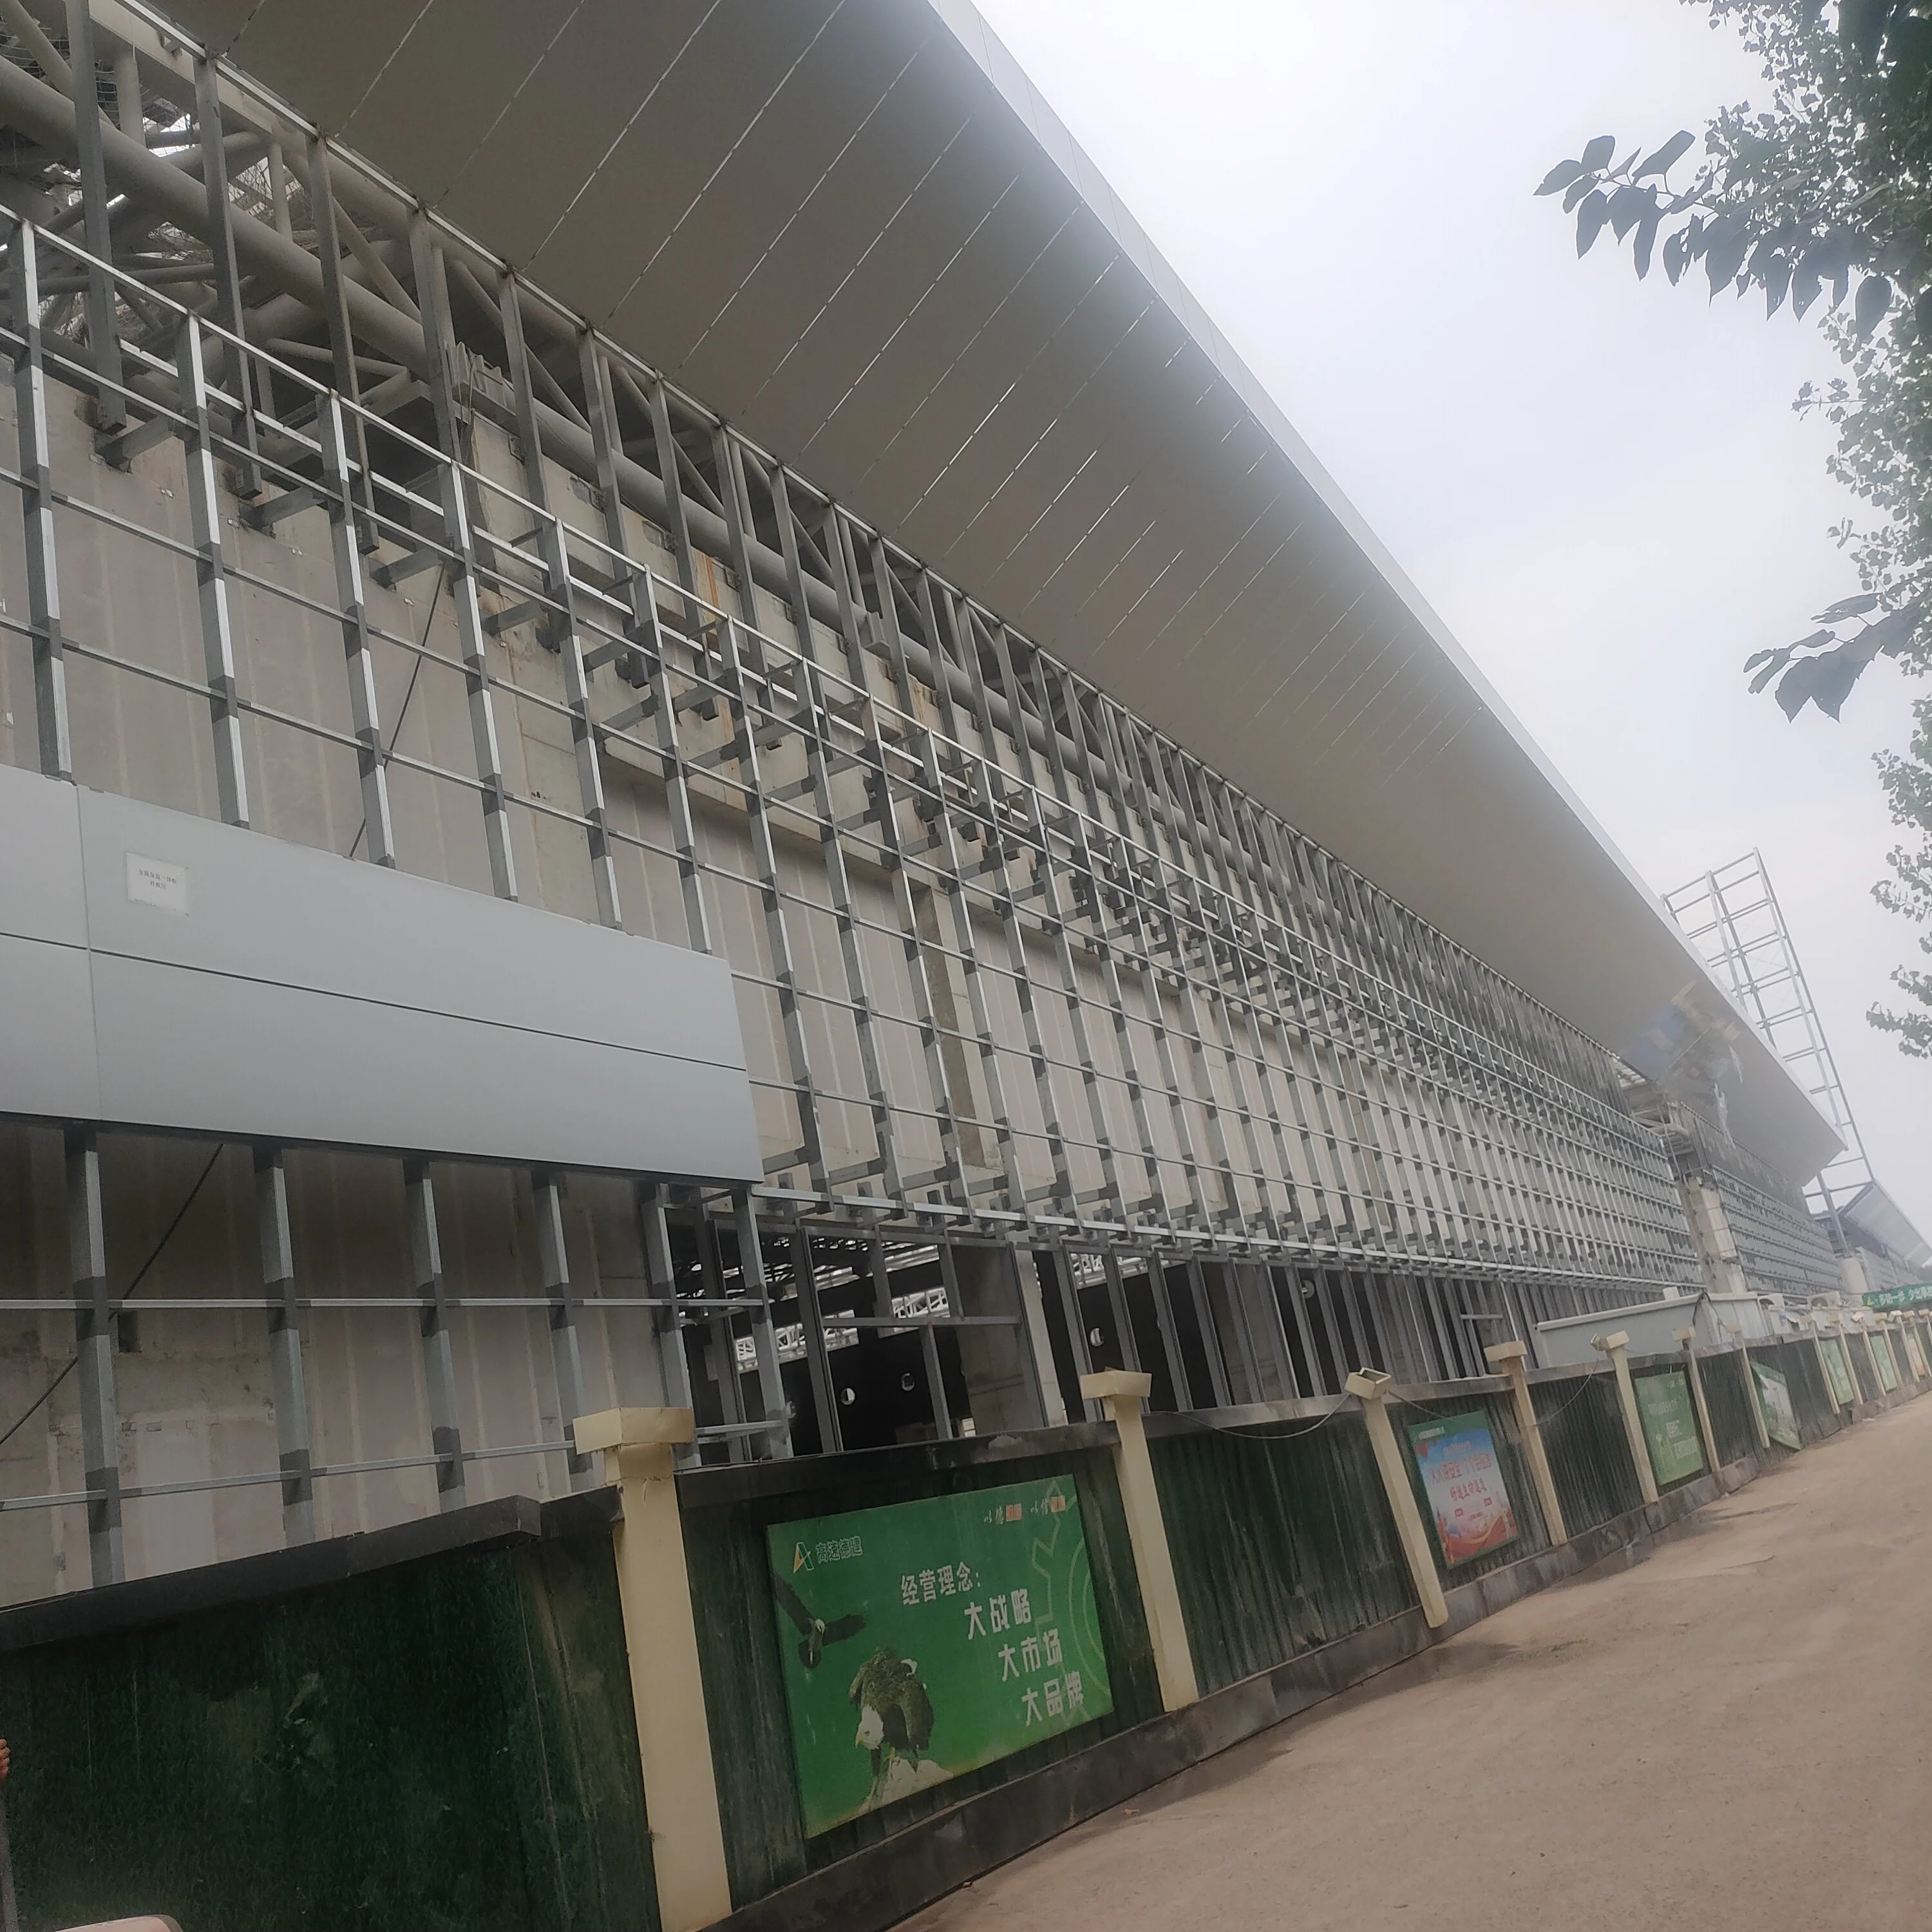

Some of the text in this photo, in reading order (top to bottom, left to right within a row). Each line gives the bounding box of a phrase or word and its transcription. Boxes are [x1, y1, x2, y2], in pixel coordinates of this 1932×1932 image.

[964, 1588, 1032, 1640] 大战略
[998, 1628, 1063, 1682] 大市场
[1021, 1671, 1084, 1726] 大品牌
